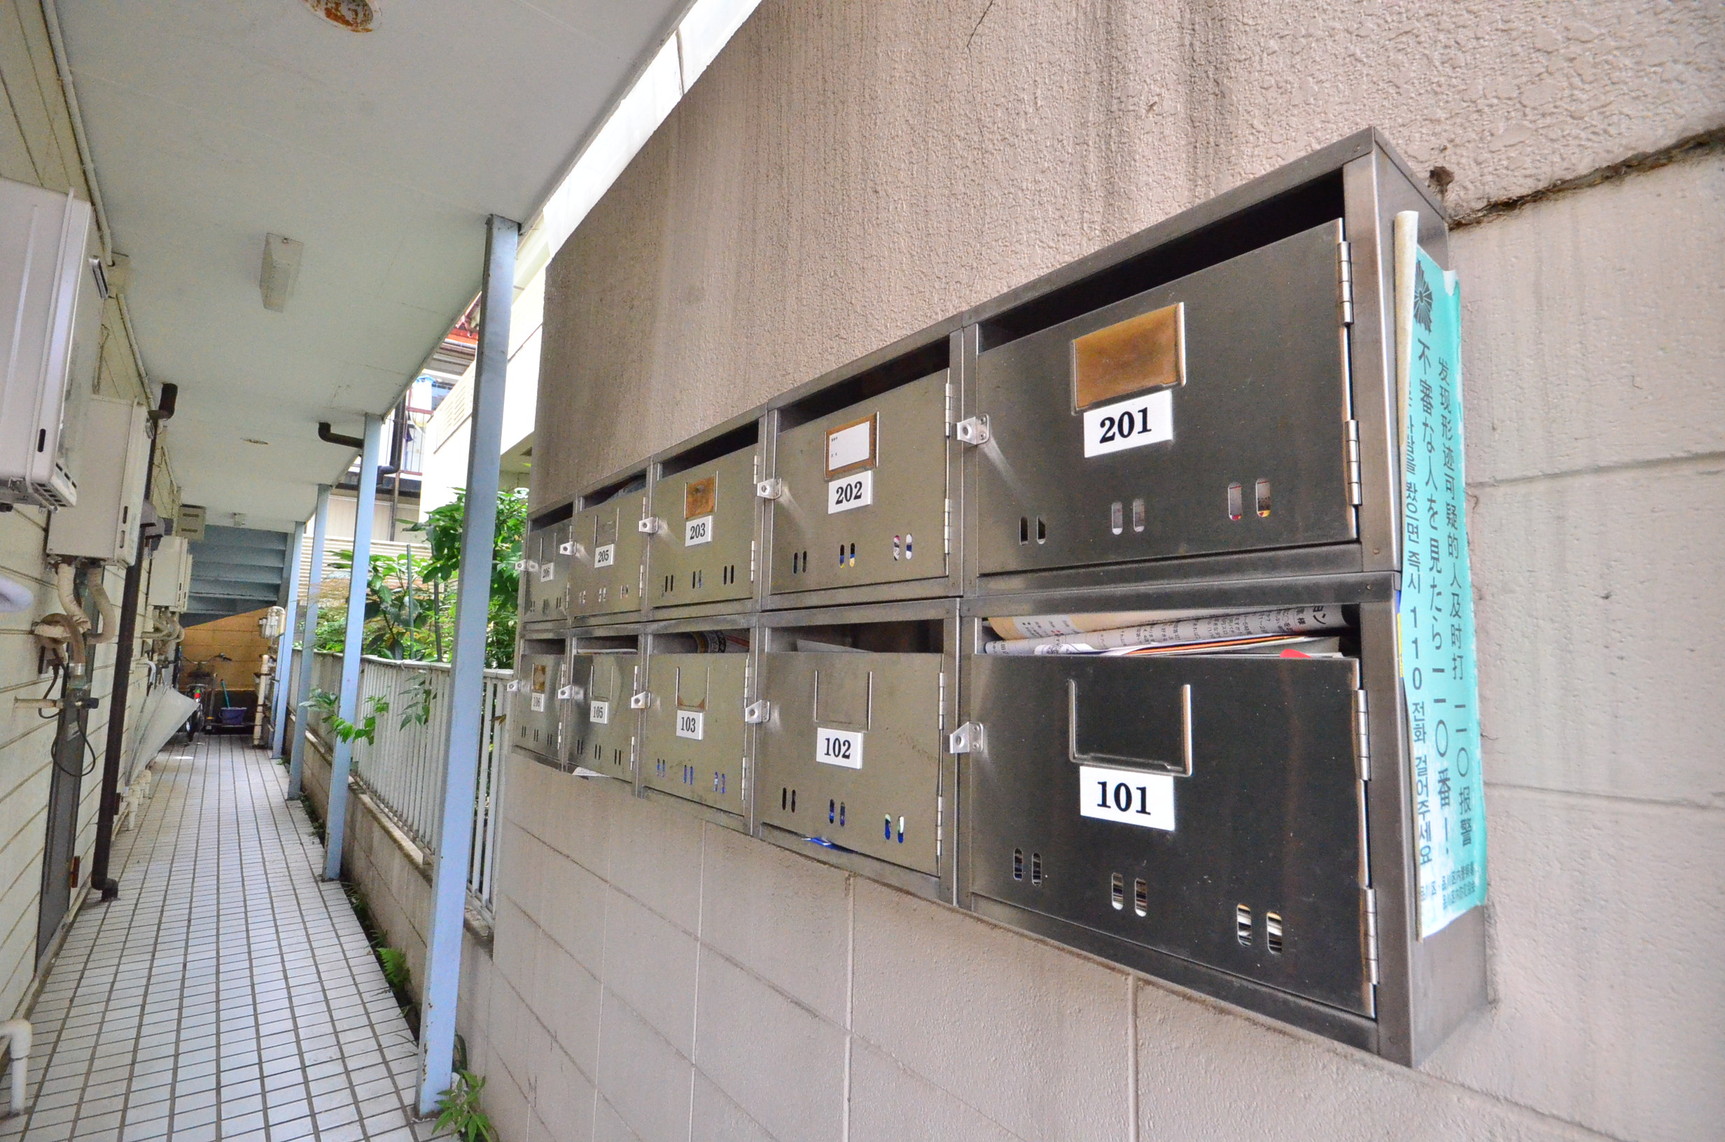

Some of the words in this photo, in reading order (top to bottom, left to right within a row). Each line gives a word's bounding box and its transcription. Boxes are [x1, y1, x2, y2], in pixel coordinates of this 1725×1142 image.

[1098, 407, 1153, 444] 201
[834, 481, 863, 505] 202
[689, 522, 706, 540] 203
[597, 549, 609, 563] 205
[1407, 550, 1422, 594] 즉시
[1409, 605, 1423, 691] 110
[593, 706, 603, 719] 105
[680, 716, 696, 733] 103
[1411, 700, 1427, 744] 전화
[823, 737, 852, 760] 102
[1096, 781, 1152, 816] 101
[1414, 754, 1433, 866] 걸어주세요
